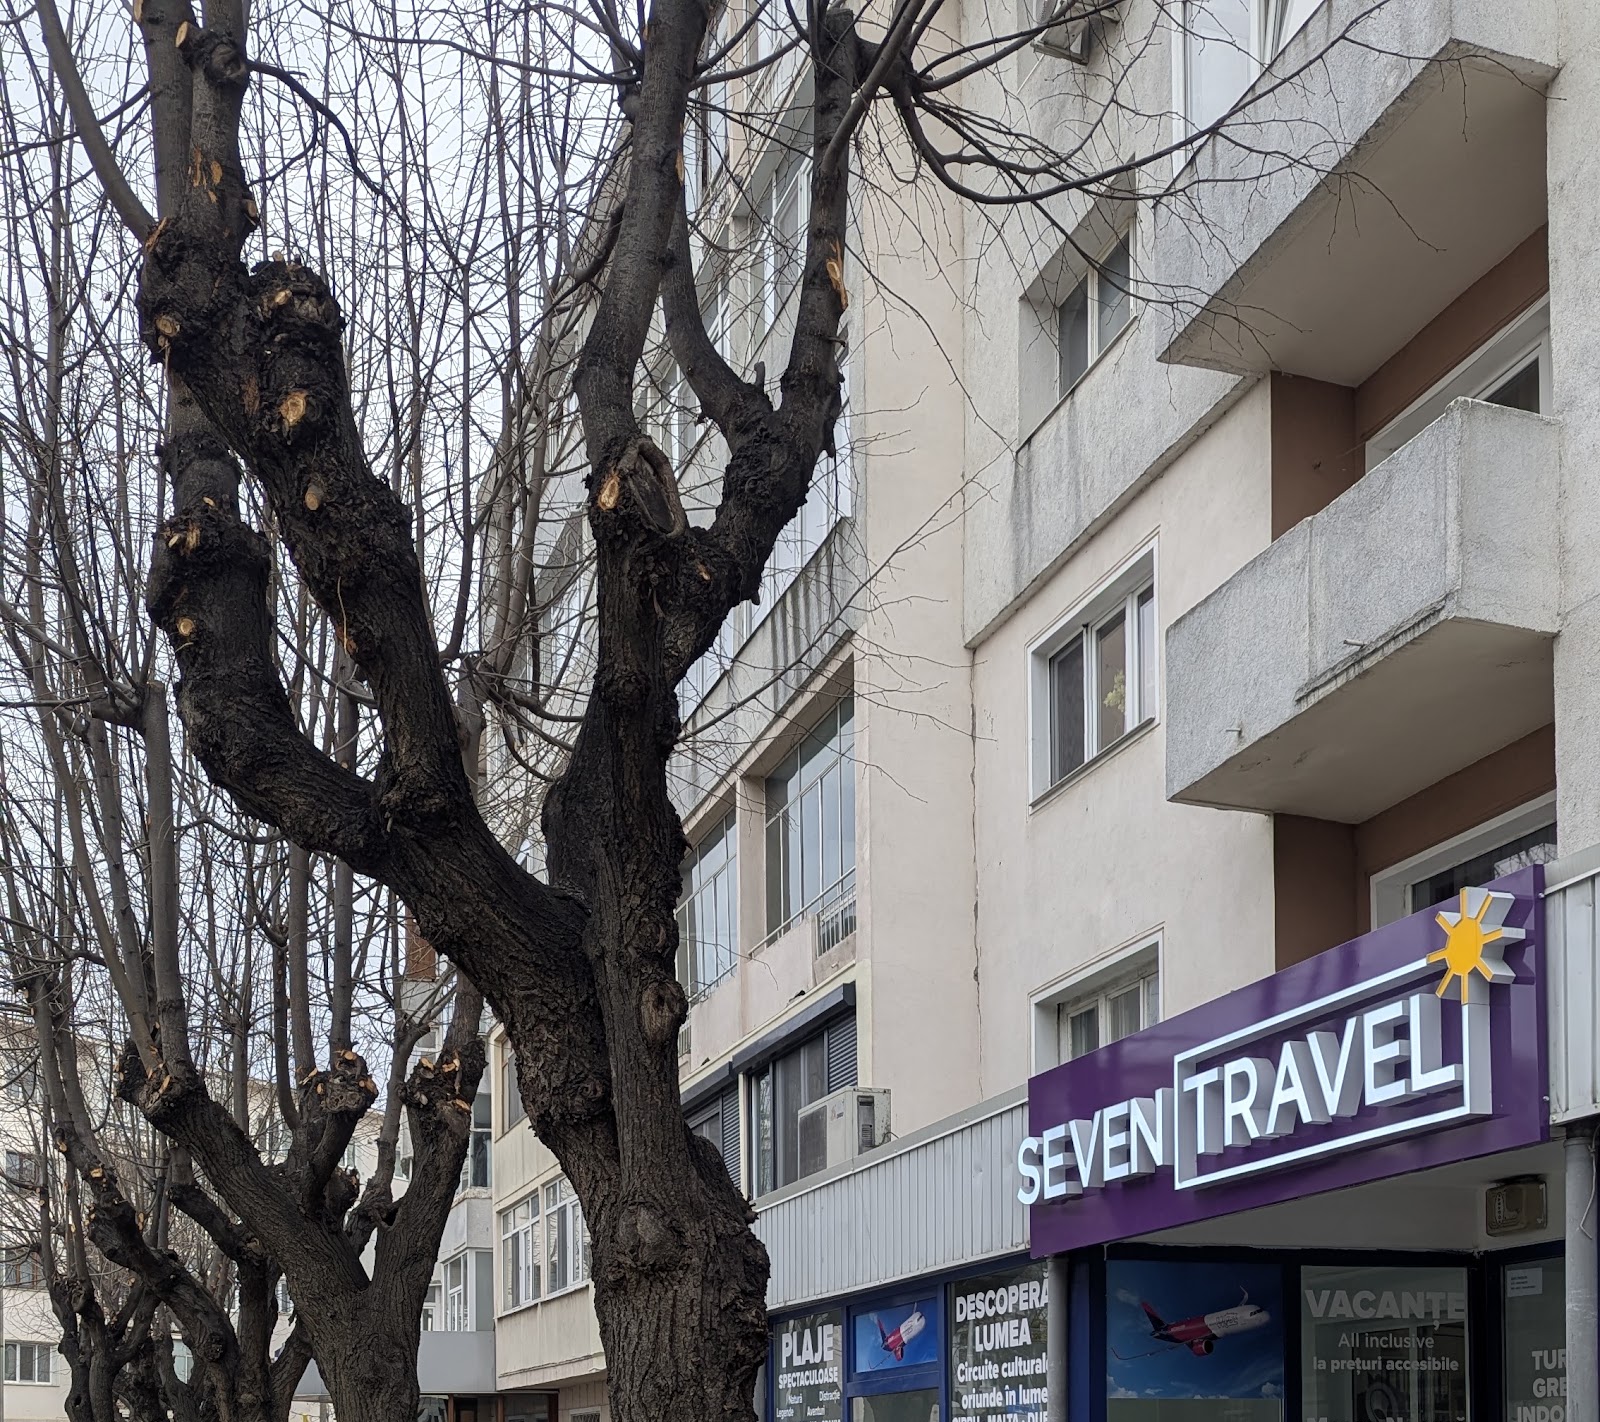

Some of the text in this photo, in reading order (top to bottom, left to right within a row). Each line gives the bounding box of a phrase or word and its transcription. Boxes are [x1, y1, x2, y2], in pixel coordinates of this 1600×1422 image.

[1017, 993, 1463, 1205] SEVEN TRAVEL
[1304, 1289, 1466, 1331] VACANȚE
[781, 1323, 834, 1368] PLAJE
[975, 1317, 1032, 1352] LUMEA
[1338, 1333, 1435, 1348] All inclusive
[957, 1358, 999, 1383] Circuite
[1312, 1356, 1459, 1375] la prețuri accesibile
[1531, 1349, 1567, 1371] TUR
[778, 1366, 839, 1389] SPECTACULOASE
[1532, 1376, 1567, 1398] GRE
[961, 1383, 1048, 1410] oriunde în lume
